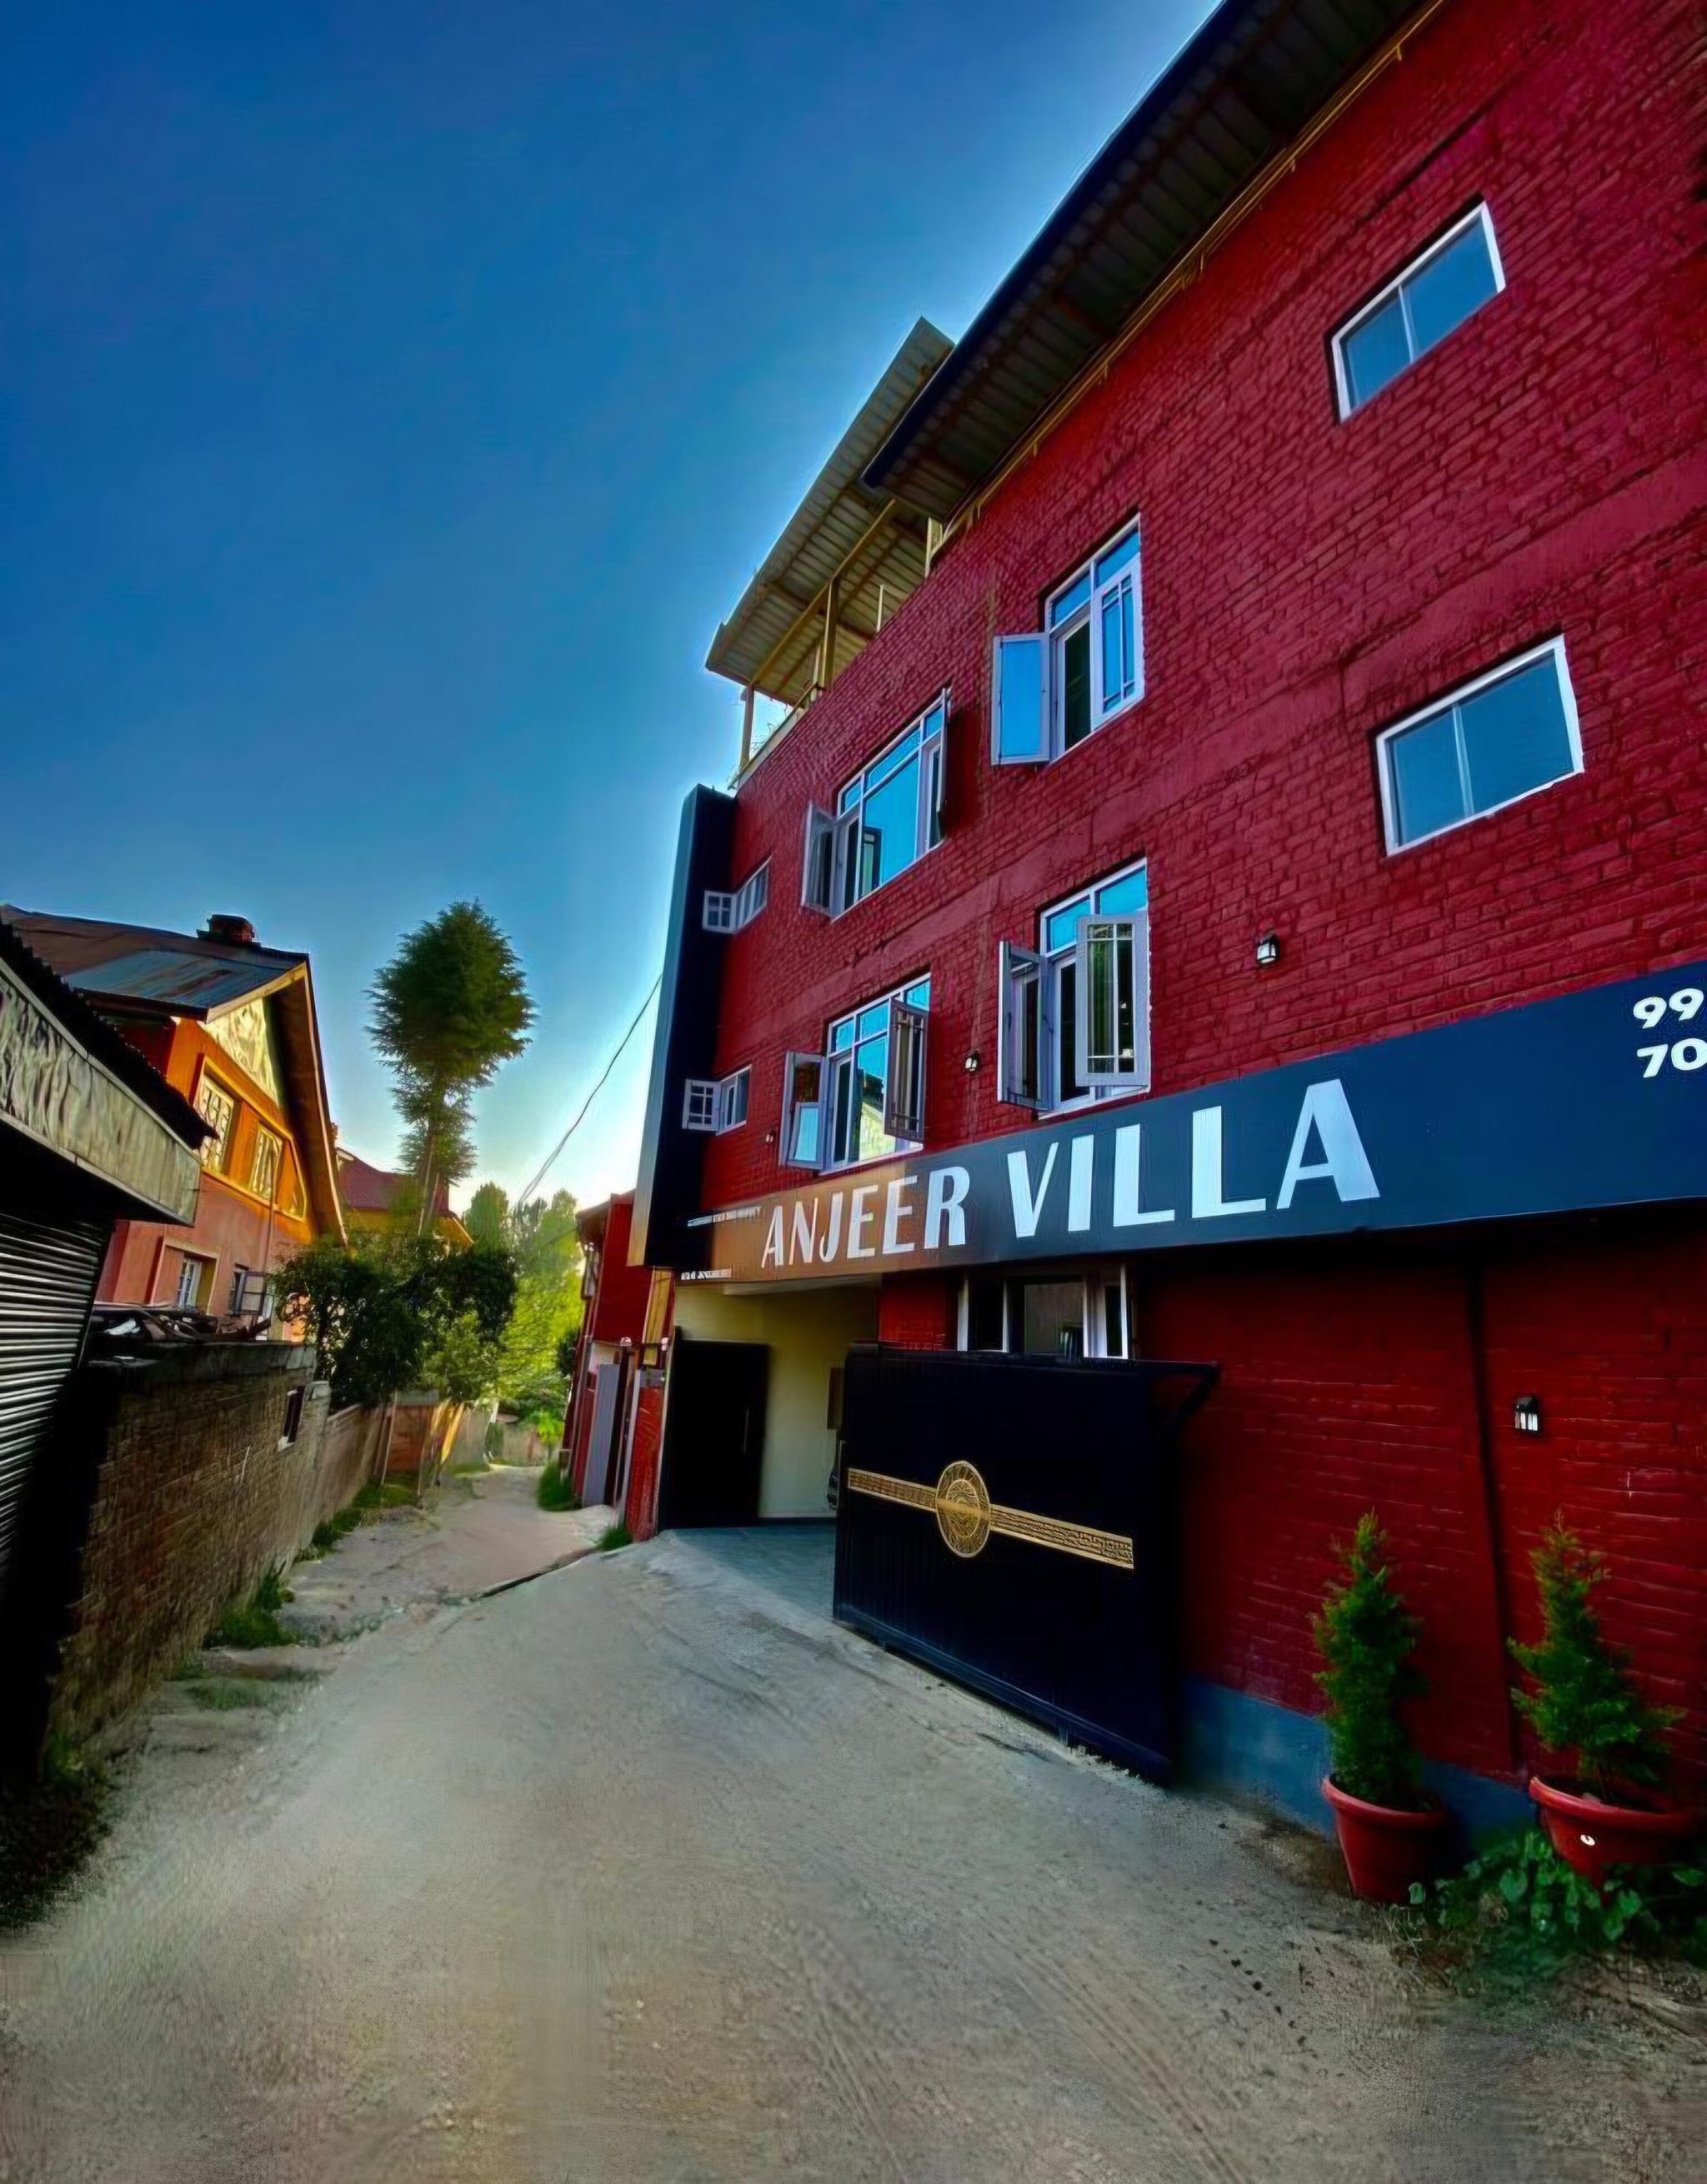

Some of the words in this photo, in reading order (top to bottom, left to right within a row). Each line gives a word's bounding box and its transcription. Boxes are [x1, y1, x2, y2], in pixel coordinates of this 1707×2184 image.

[1633, 987, 1705, 1029] 99
[1636, 1037, 1707, 1078] 70
[761, 1165, 969, 1269] ANJEER
[1007, 1077, 1381, 1238] VILLA
